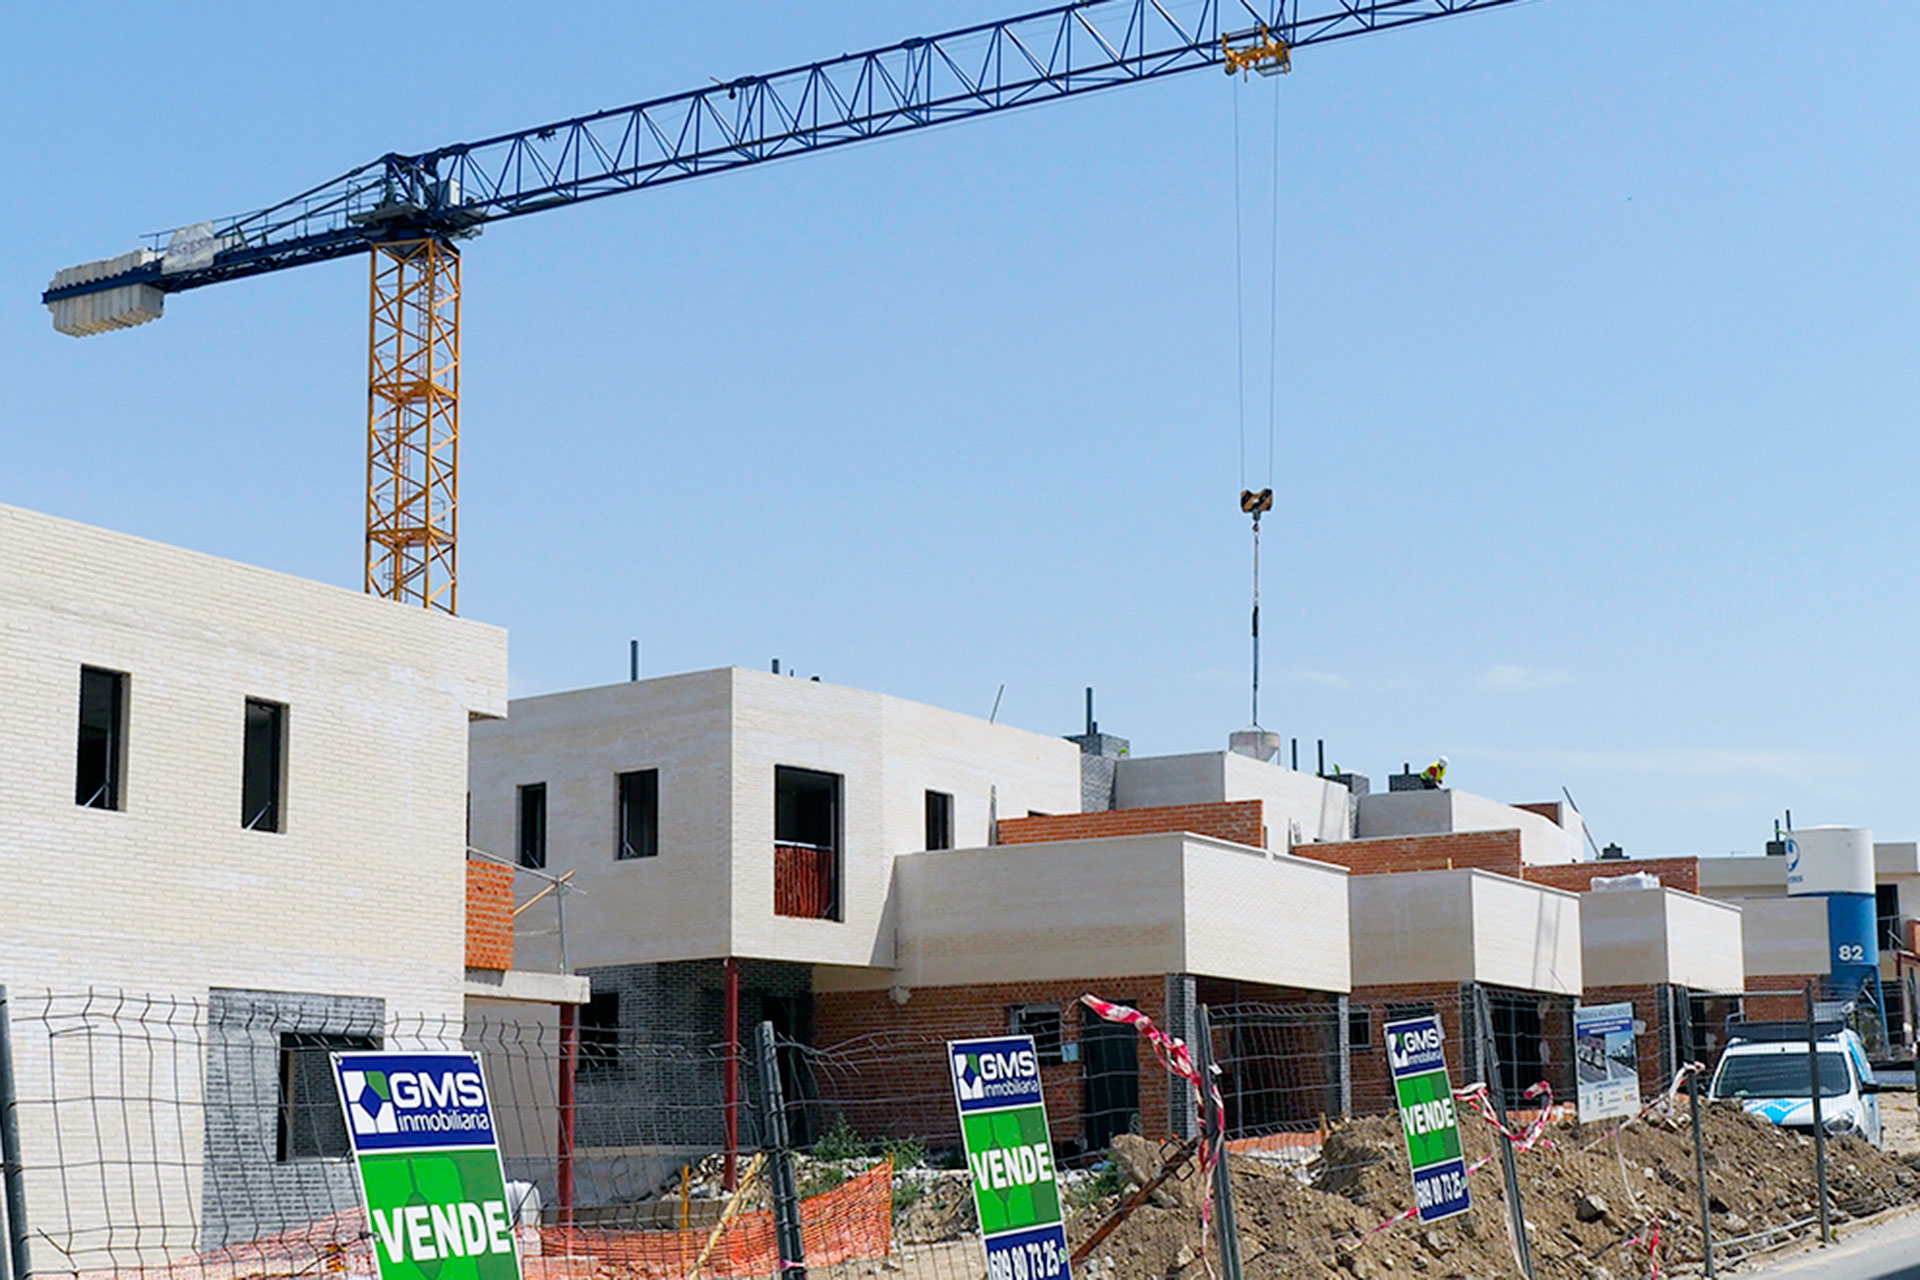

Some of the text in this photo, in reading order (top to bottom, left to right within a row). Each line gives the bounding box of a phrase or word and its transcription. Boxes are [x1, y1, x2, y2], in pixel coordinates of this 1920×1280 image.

[1838, 945, 1864, 961] 82
[1404, 1029, 1439, 1052] GMS
[979, 1051, 1035, 1080] GMS
[390, 1072, 485, 1108] GMS
[983, 1078, 1039, 1098] inmobiliaria
[396, 1108, 490, 1132] inmobiliaria
[1402, 1098, 1454, 1136] VENDE
[971, 1143, 1052, 1191] VENDE
[372, 1200, 512, 1264] VENDE
[1026, 1242, 1045, 1280] 73
[1042, 1239, 1060, 1277] 25
